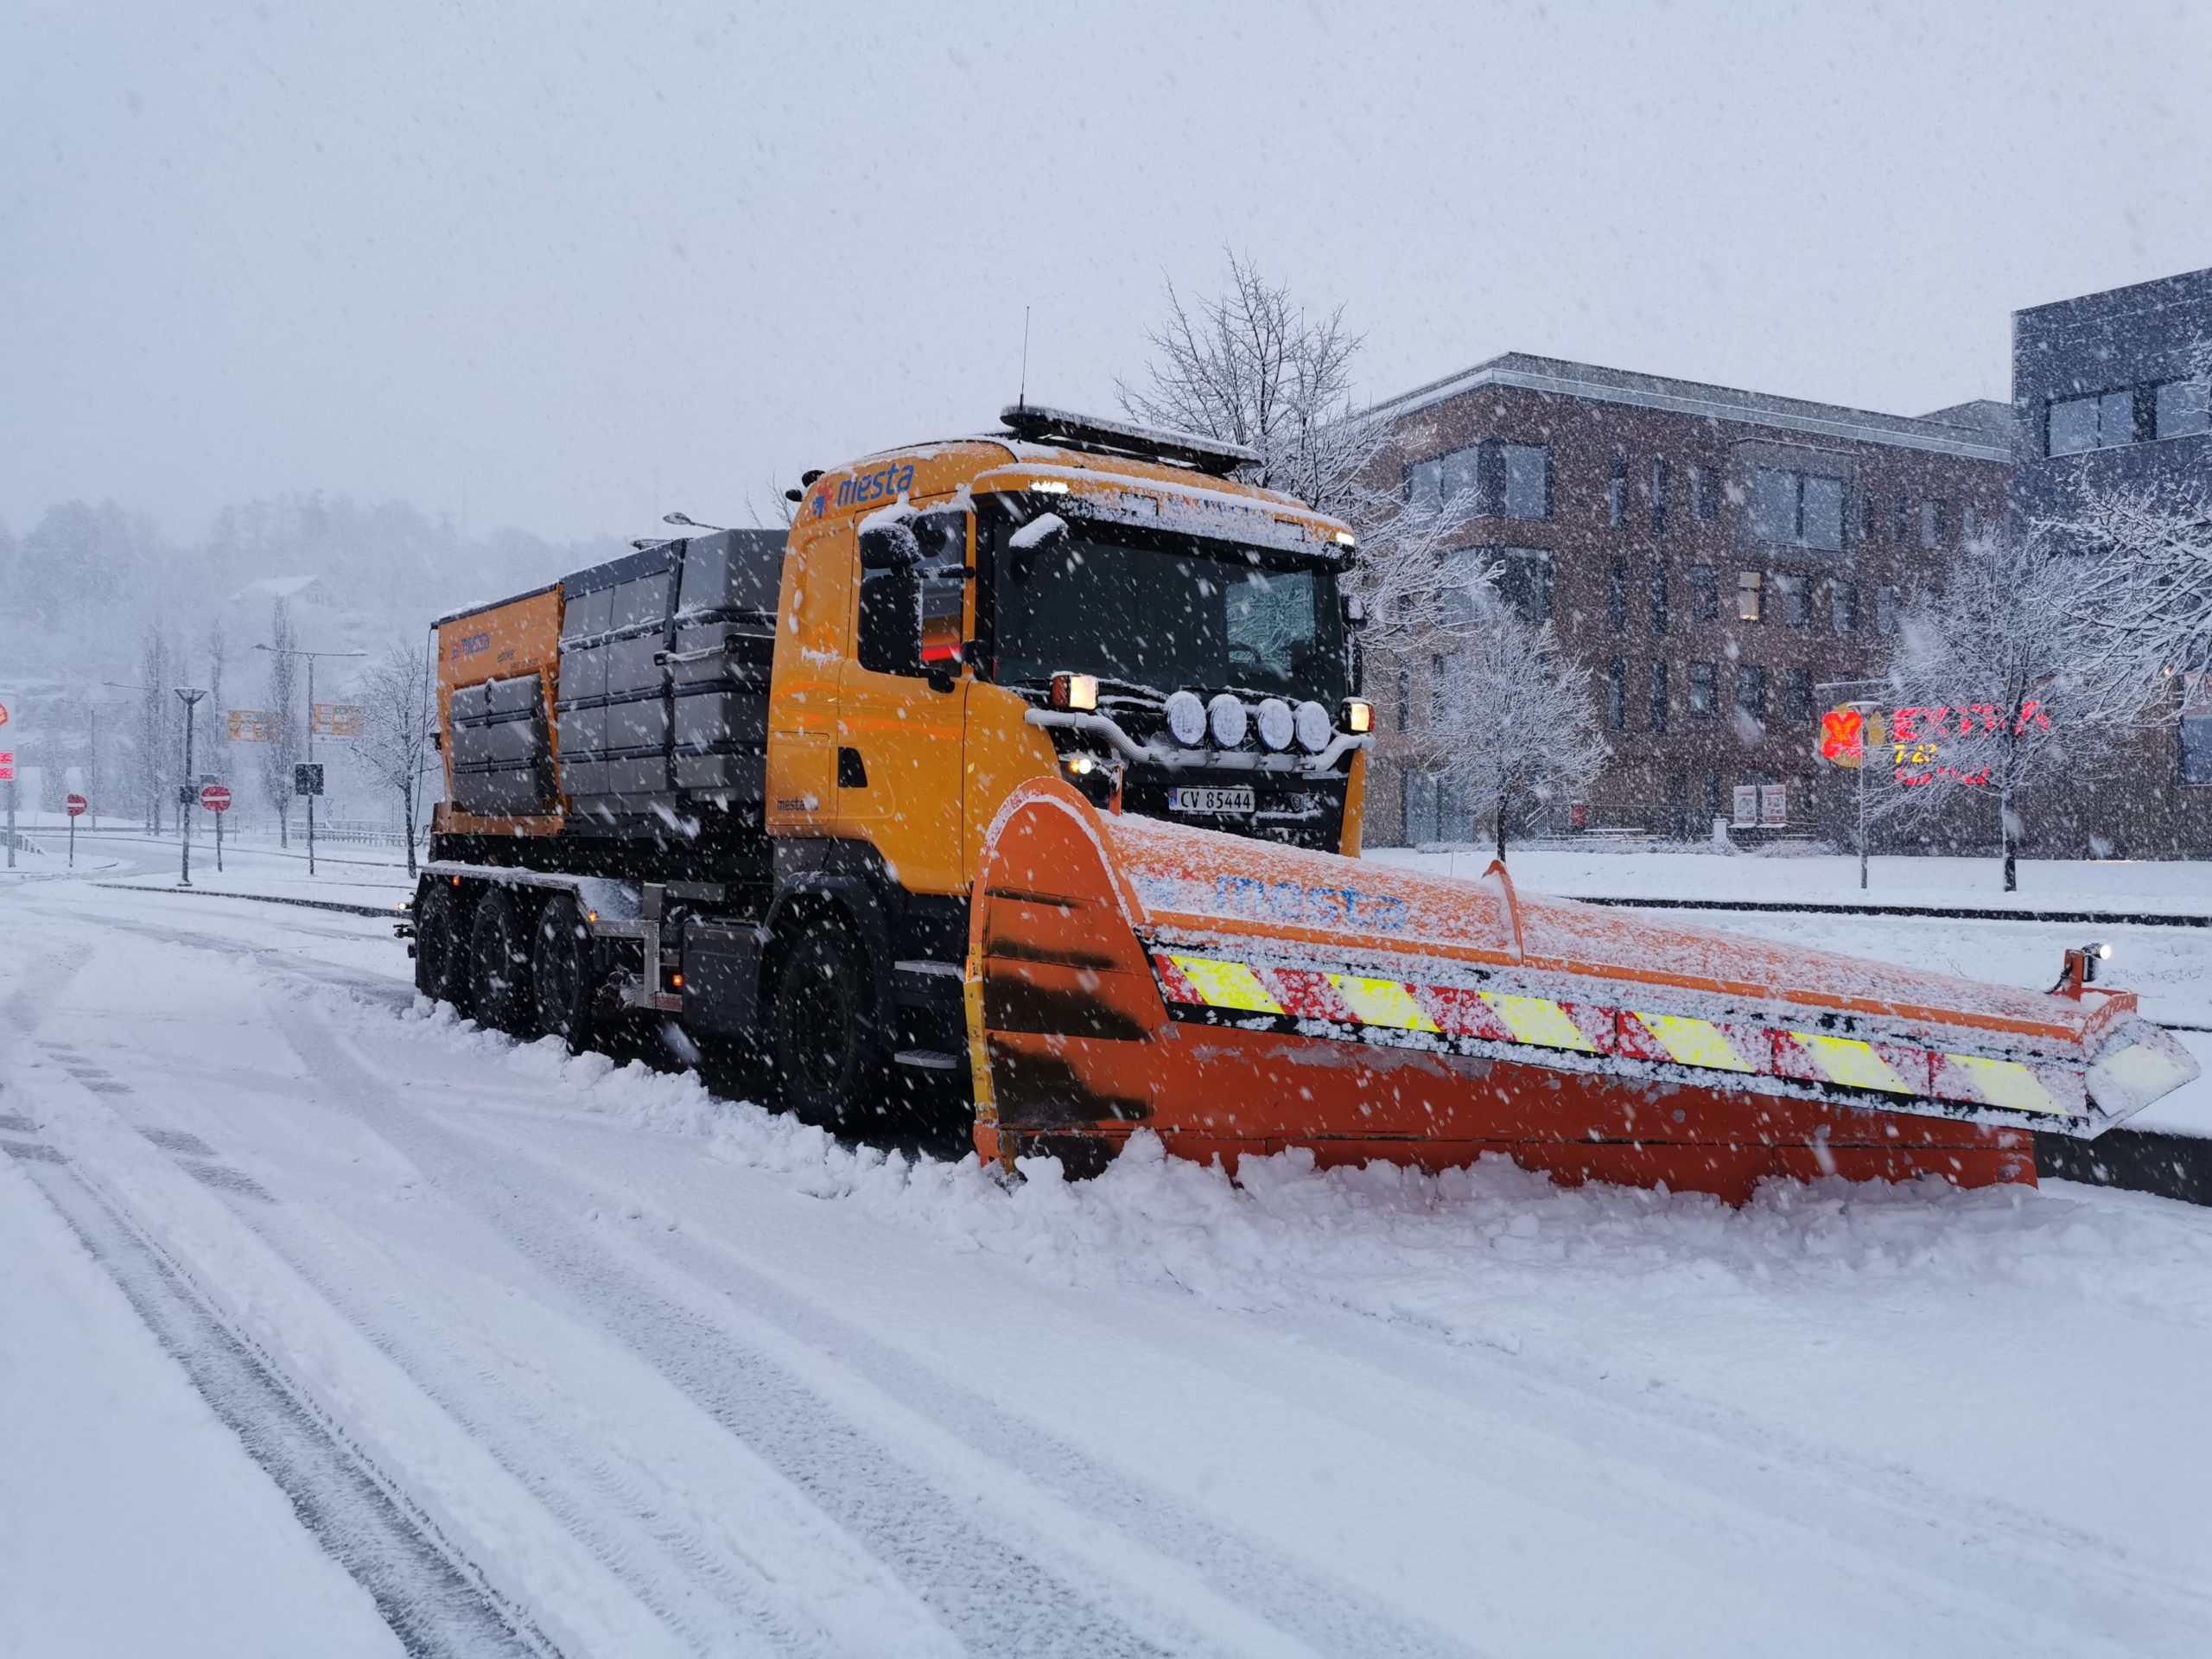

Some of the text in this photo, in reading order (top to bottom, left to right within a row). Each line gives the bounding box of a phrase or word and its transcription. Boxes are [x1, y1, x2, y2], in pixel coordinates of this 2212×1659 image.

[836, 462, 914, 508] mesta
[1180, 791, 1252, 810] CV 85444
[1217, 875, 1407, 931] mesta
